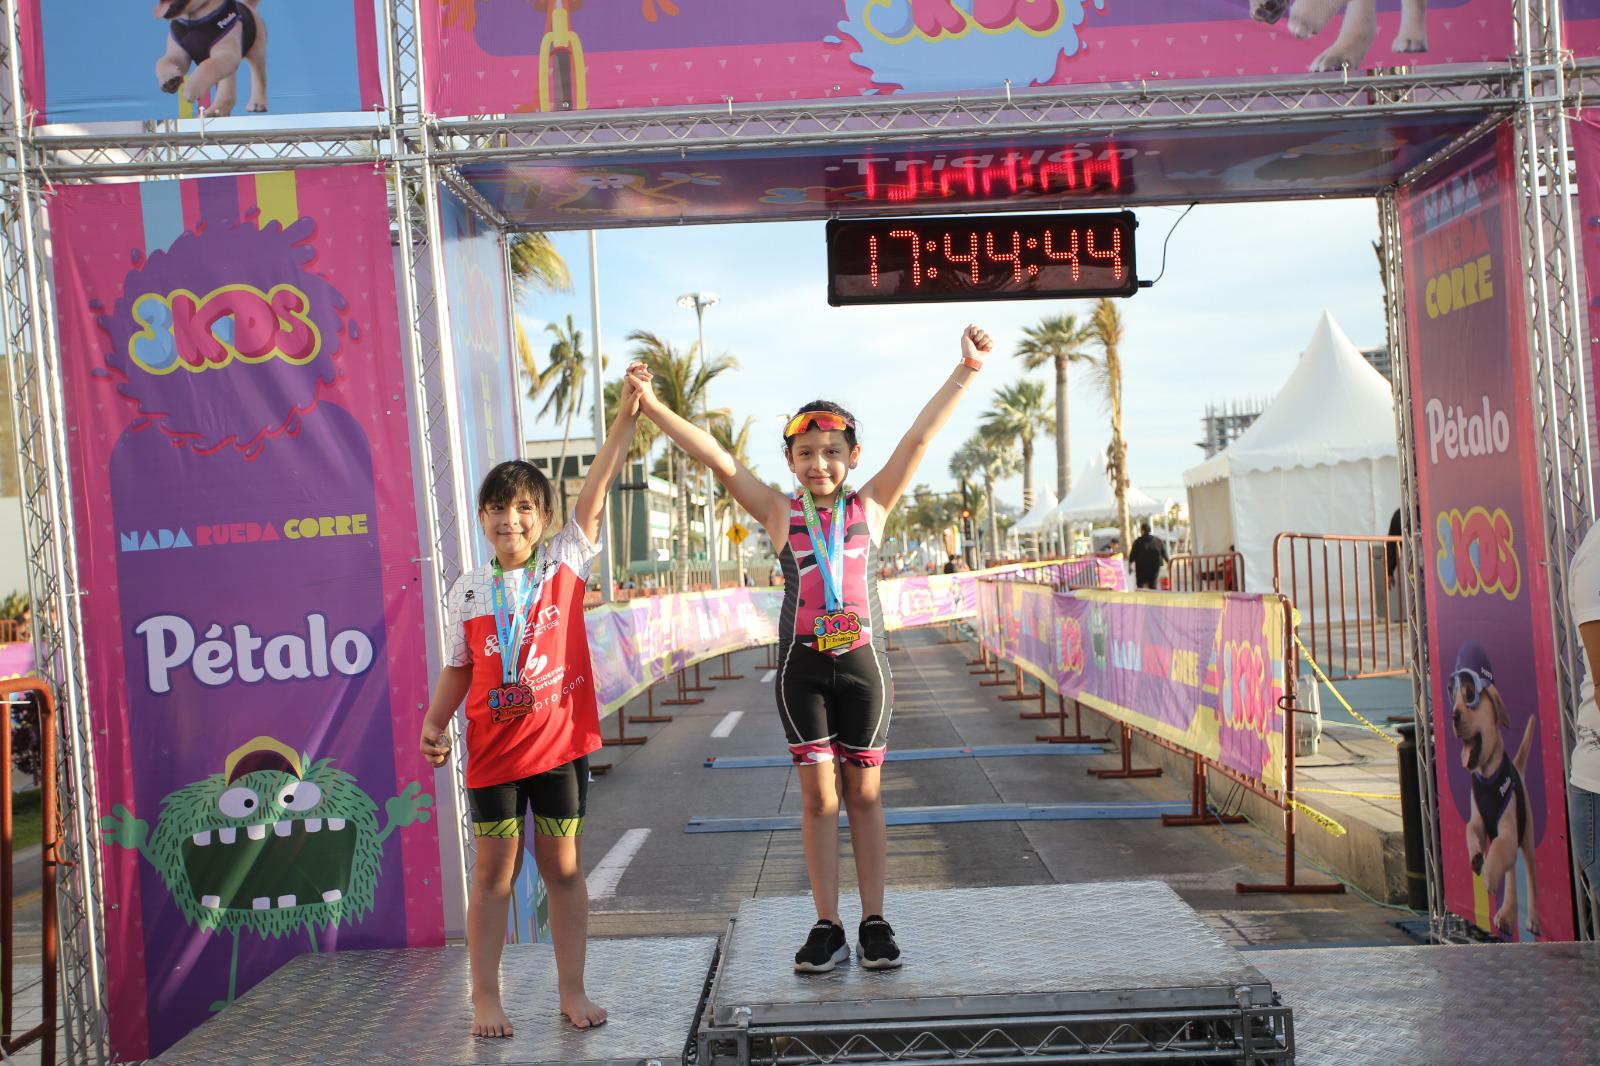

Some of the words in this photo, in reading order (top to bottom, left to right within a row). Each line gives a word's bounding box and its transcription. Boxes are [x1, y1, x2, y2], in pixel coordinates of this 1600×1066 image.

[869, 227, 1122, 287] 17:44:44
[1425, 253, 1494, 320] CORRE
[1425, 394, 1511, 465] Pétalo
[119, 526, 193, 553] NADA
[195, 520, 281, 548] RUEDA
[283, 513, 369, 540] CORRE
[135, 613, 374, 694] Pétalo
